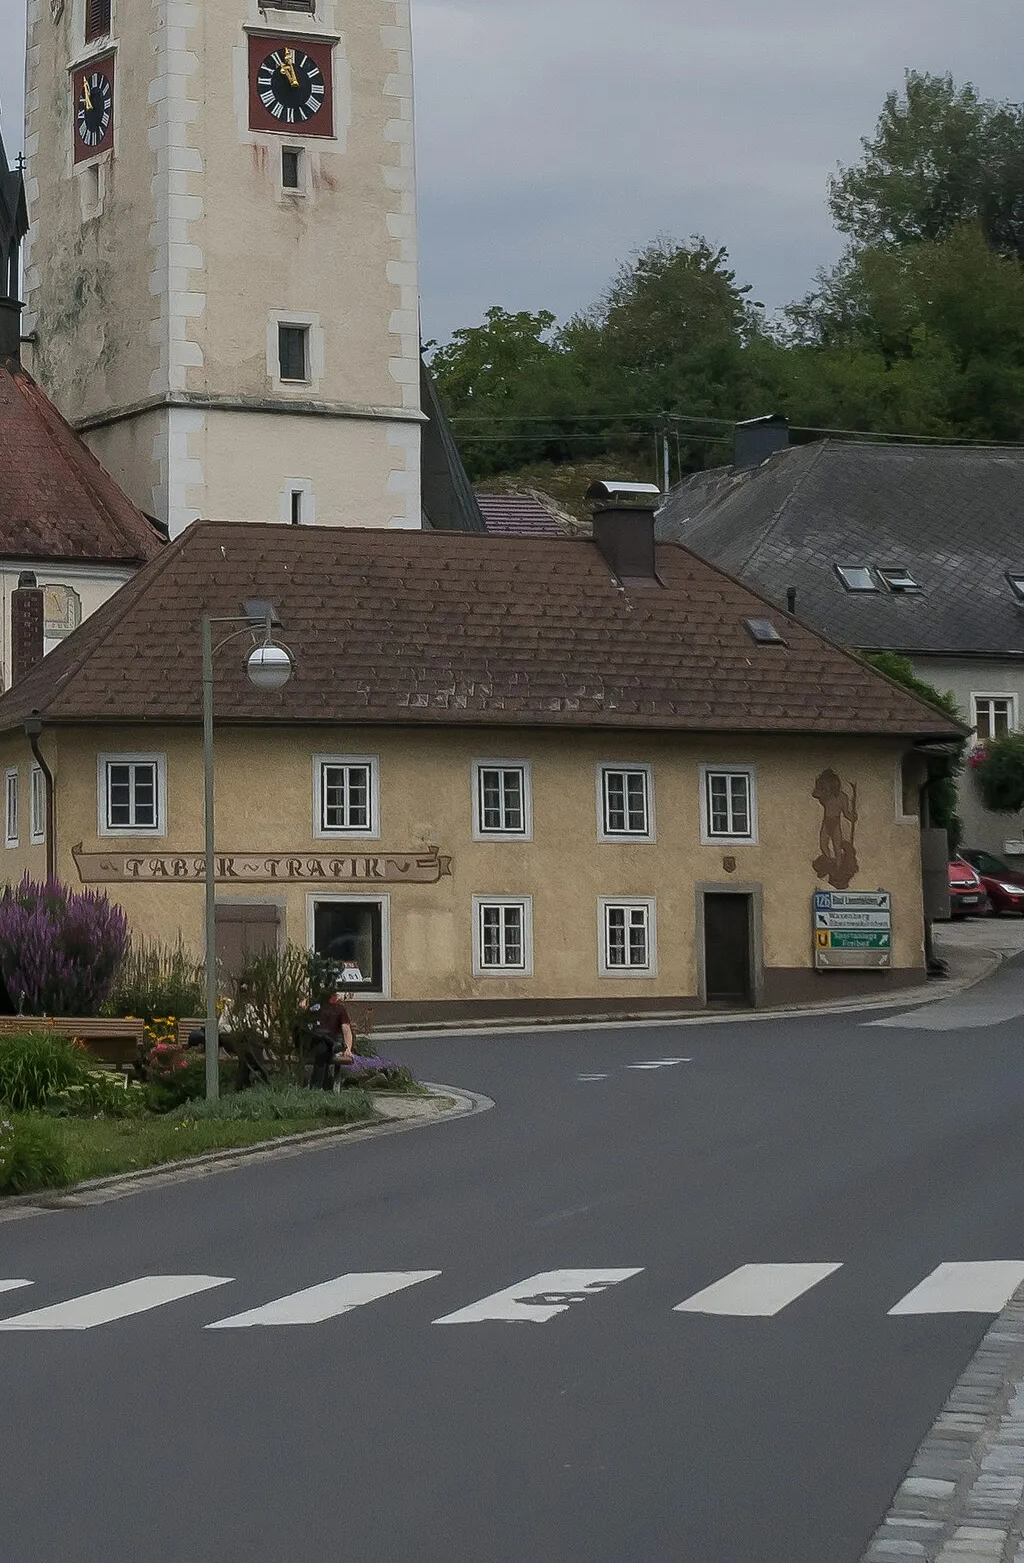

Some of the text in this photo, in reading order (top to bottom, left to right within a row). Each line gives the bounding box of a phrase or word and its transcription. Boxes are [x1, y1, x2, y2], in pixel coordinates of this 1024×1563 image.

[306, 67, 320, 78] II
[311, 84, 324, 94] III
[126, 858, 384, 878] TABAK TRAFIK
[818, 934, 828, 946] U
